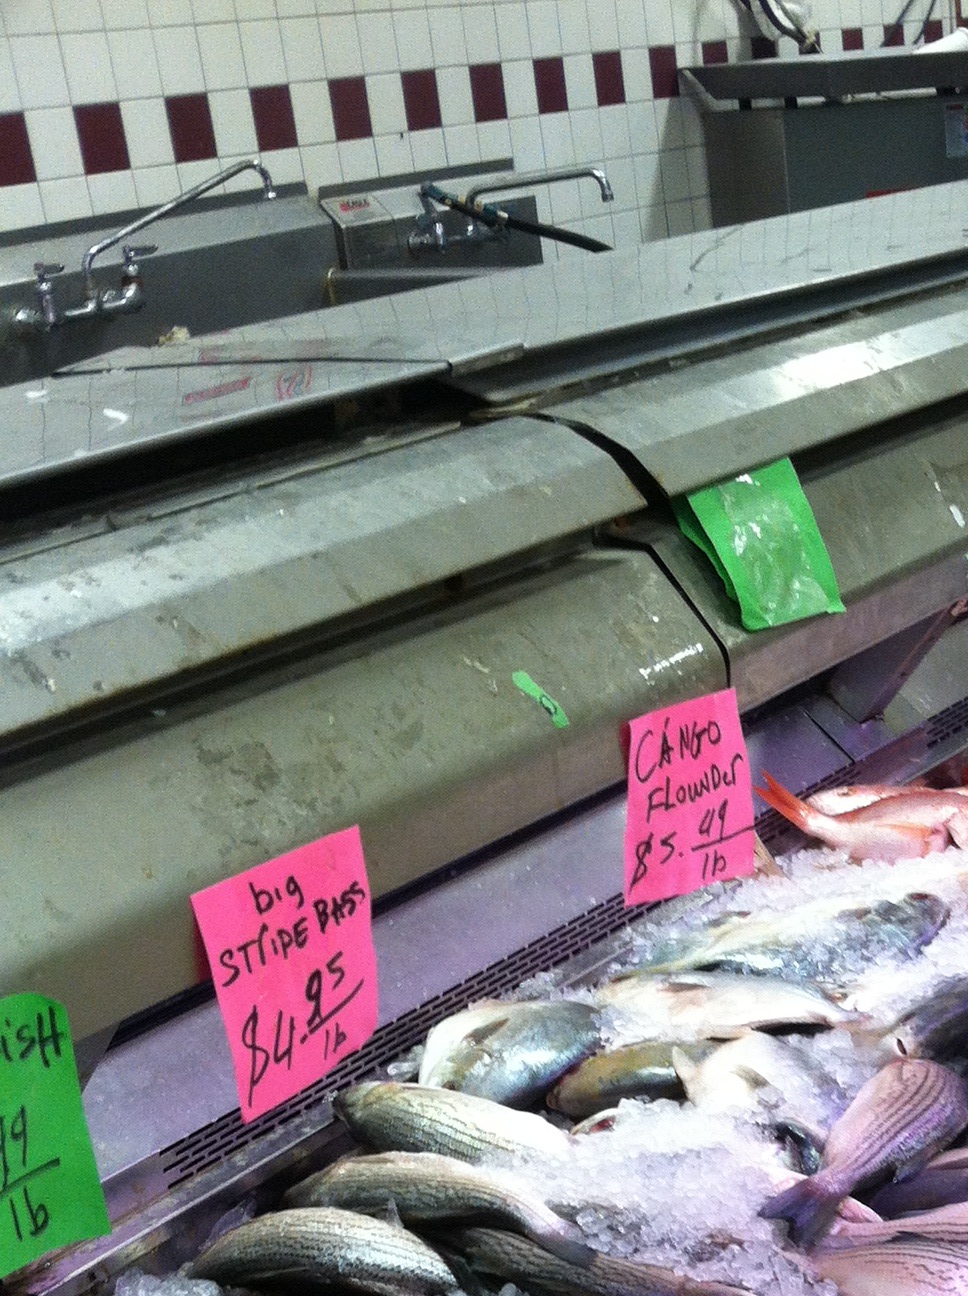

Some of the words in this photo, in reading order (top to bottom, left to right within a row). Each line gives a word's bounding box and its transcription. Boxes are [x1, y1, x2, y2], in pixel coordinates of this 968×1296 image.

[702, 849, 727, 880] lb
[313, 881, 365, 934] BASS
[324, 1021, 347, 1060] lb
[9, 1185, 49, 1242] lb
